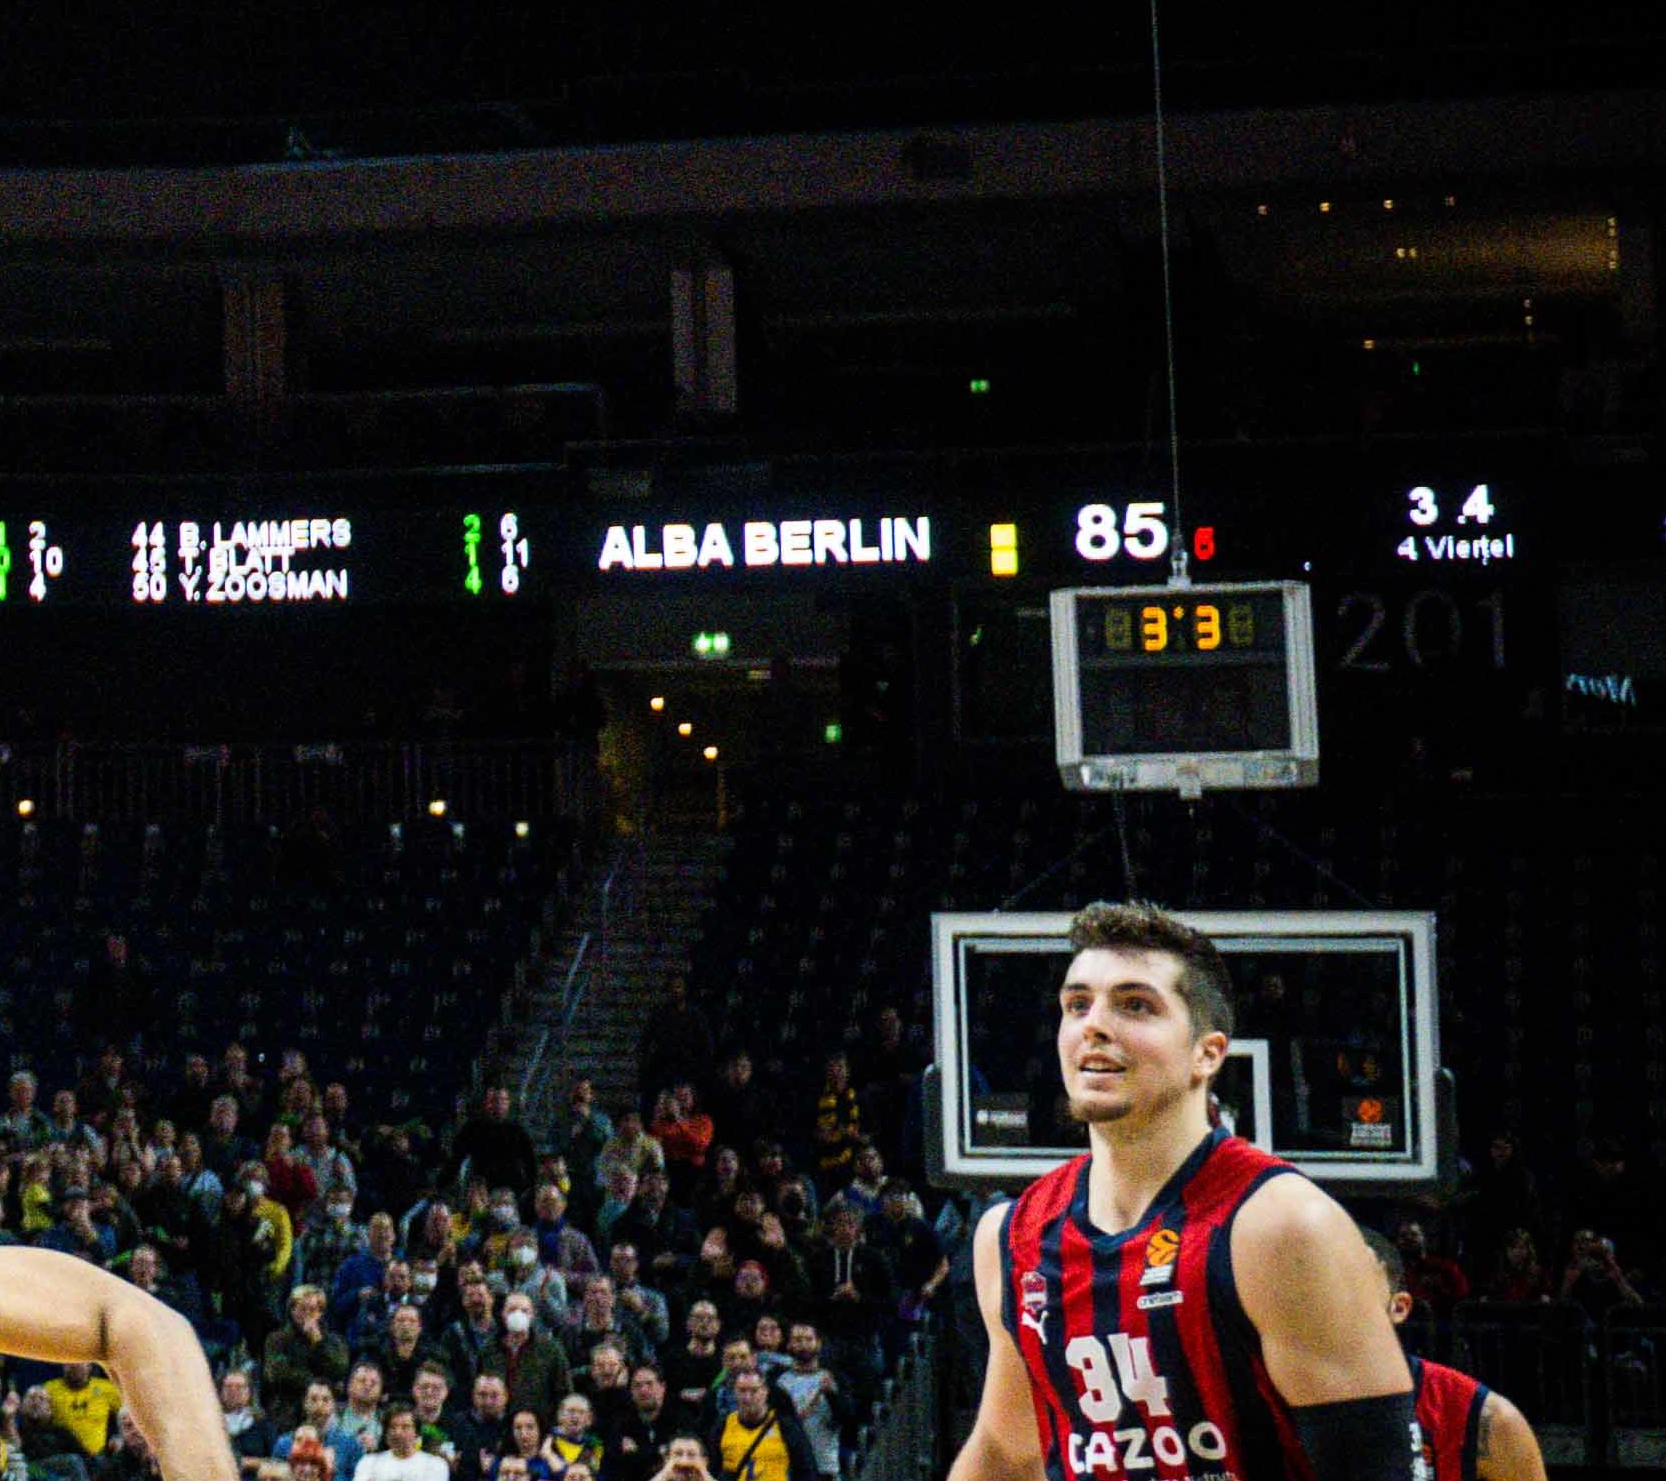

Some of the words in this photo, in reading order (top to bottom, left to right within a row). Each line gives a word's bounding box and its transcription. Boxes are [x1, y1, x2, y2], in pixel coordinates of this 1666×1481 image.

[209, 547, 296, 575] BLATT
[599, 523, 734, 570] ALBA
[744, 516, 930, 566] BERLIN
[1075, 502, 1168, 561] 85
[1397, 535, 1419, 561] 4
[1425, 533, 1514, 566] Viertel
[1065, 1332, 1172, 1423] 34
[1068, 1421, 1227, 1474] CAZOO
